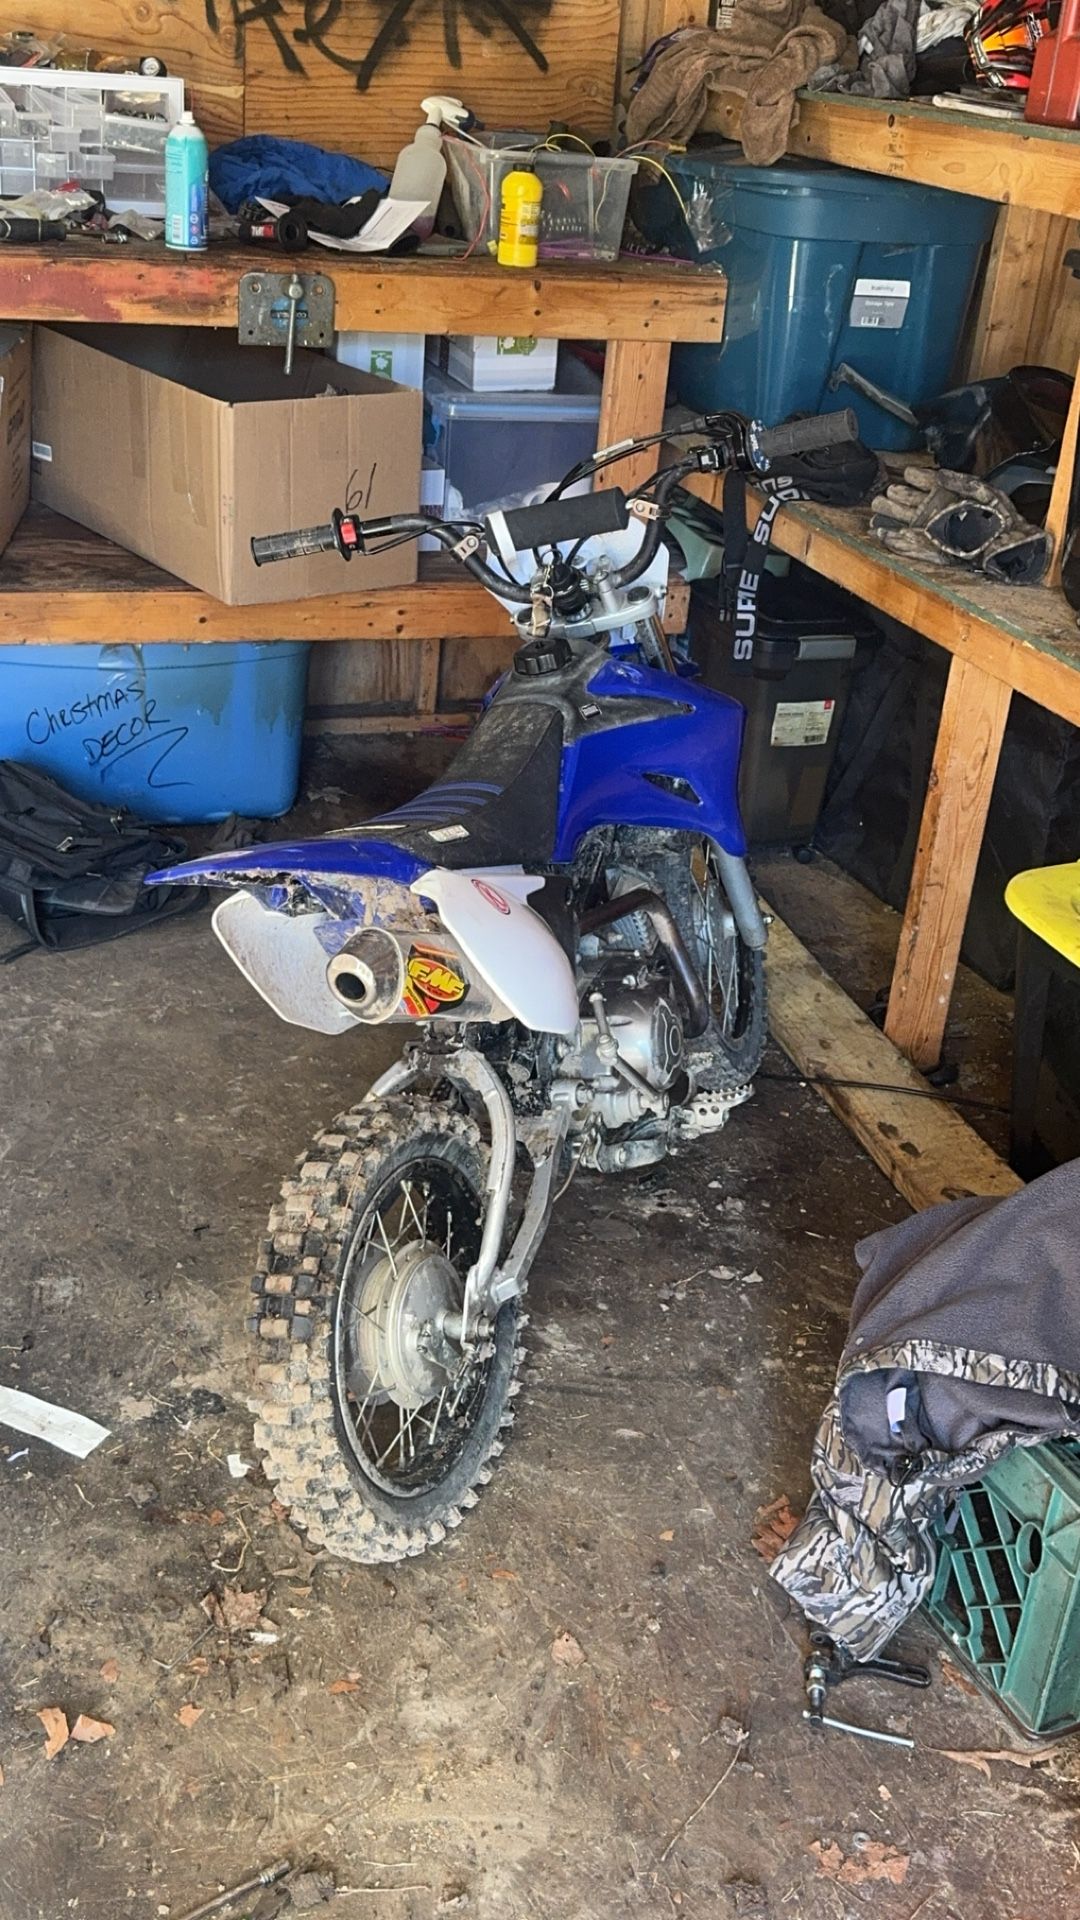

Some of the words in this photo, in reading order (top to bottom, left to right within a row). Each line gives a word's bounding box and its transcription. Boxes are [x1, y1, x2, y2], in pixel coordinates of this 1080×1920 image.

[345, 462, 377, 513] 61
[82, 699, 171, 766] DECOR
[409, 961, 465, 995] FMF
